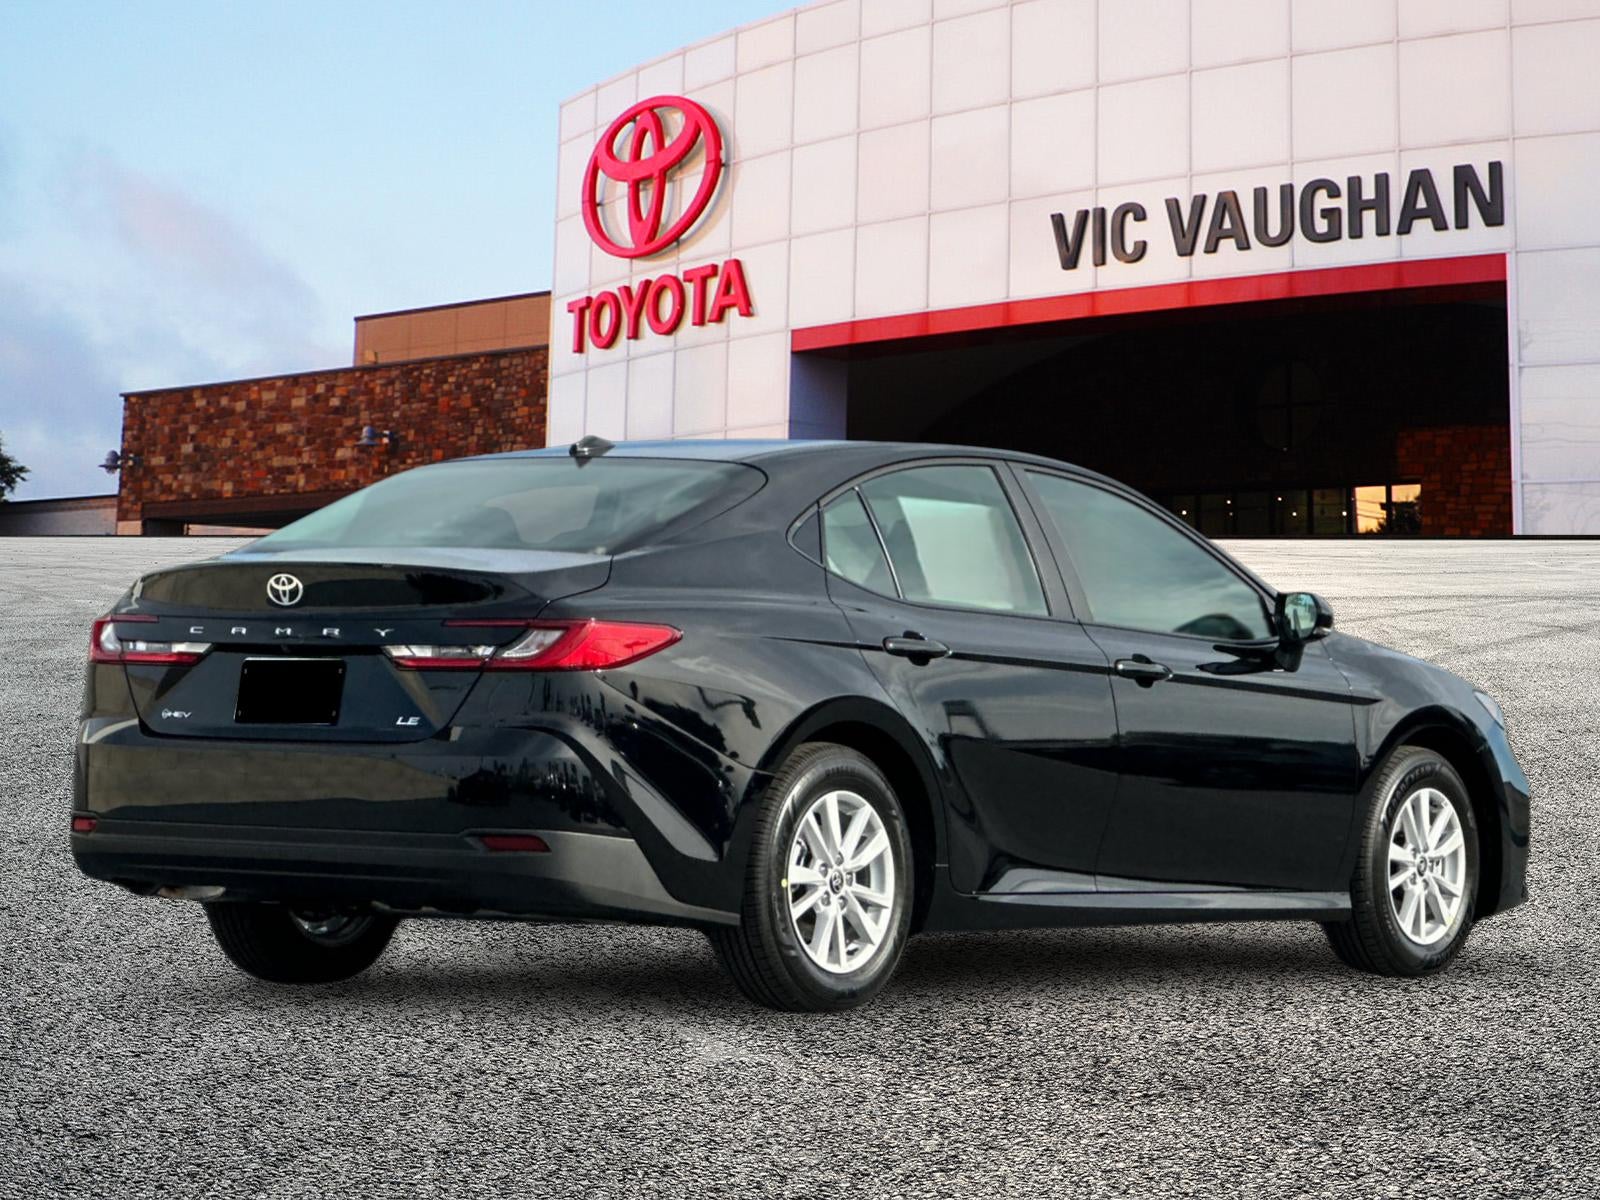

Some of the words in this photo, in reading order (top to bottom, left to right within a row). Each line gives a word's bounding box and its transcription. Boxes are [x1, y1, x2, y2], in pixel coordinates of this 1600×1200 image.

[1050, 201, 1148, 271] VIC
[1165, 160, 1505, 257] VAUGHAN
[567, 258, 754, 354] TOYOTA
[189, 625, 395, 638] CAMRY
[396, 716, 421, 726] LE
